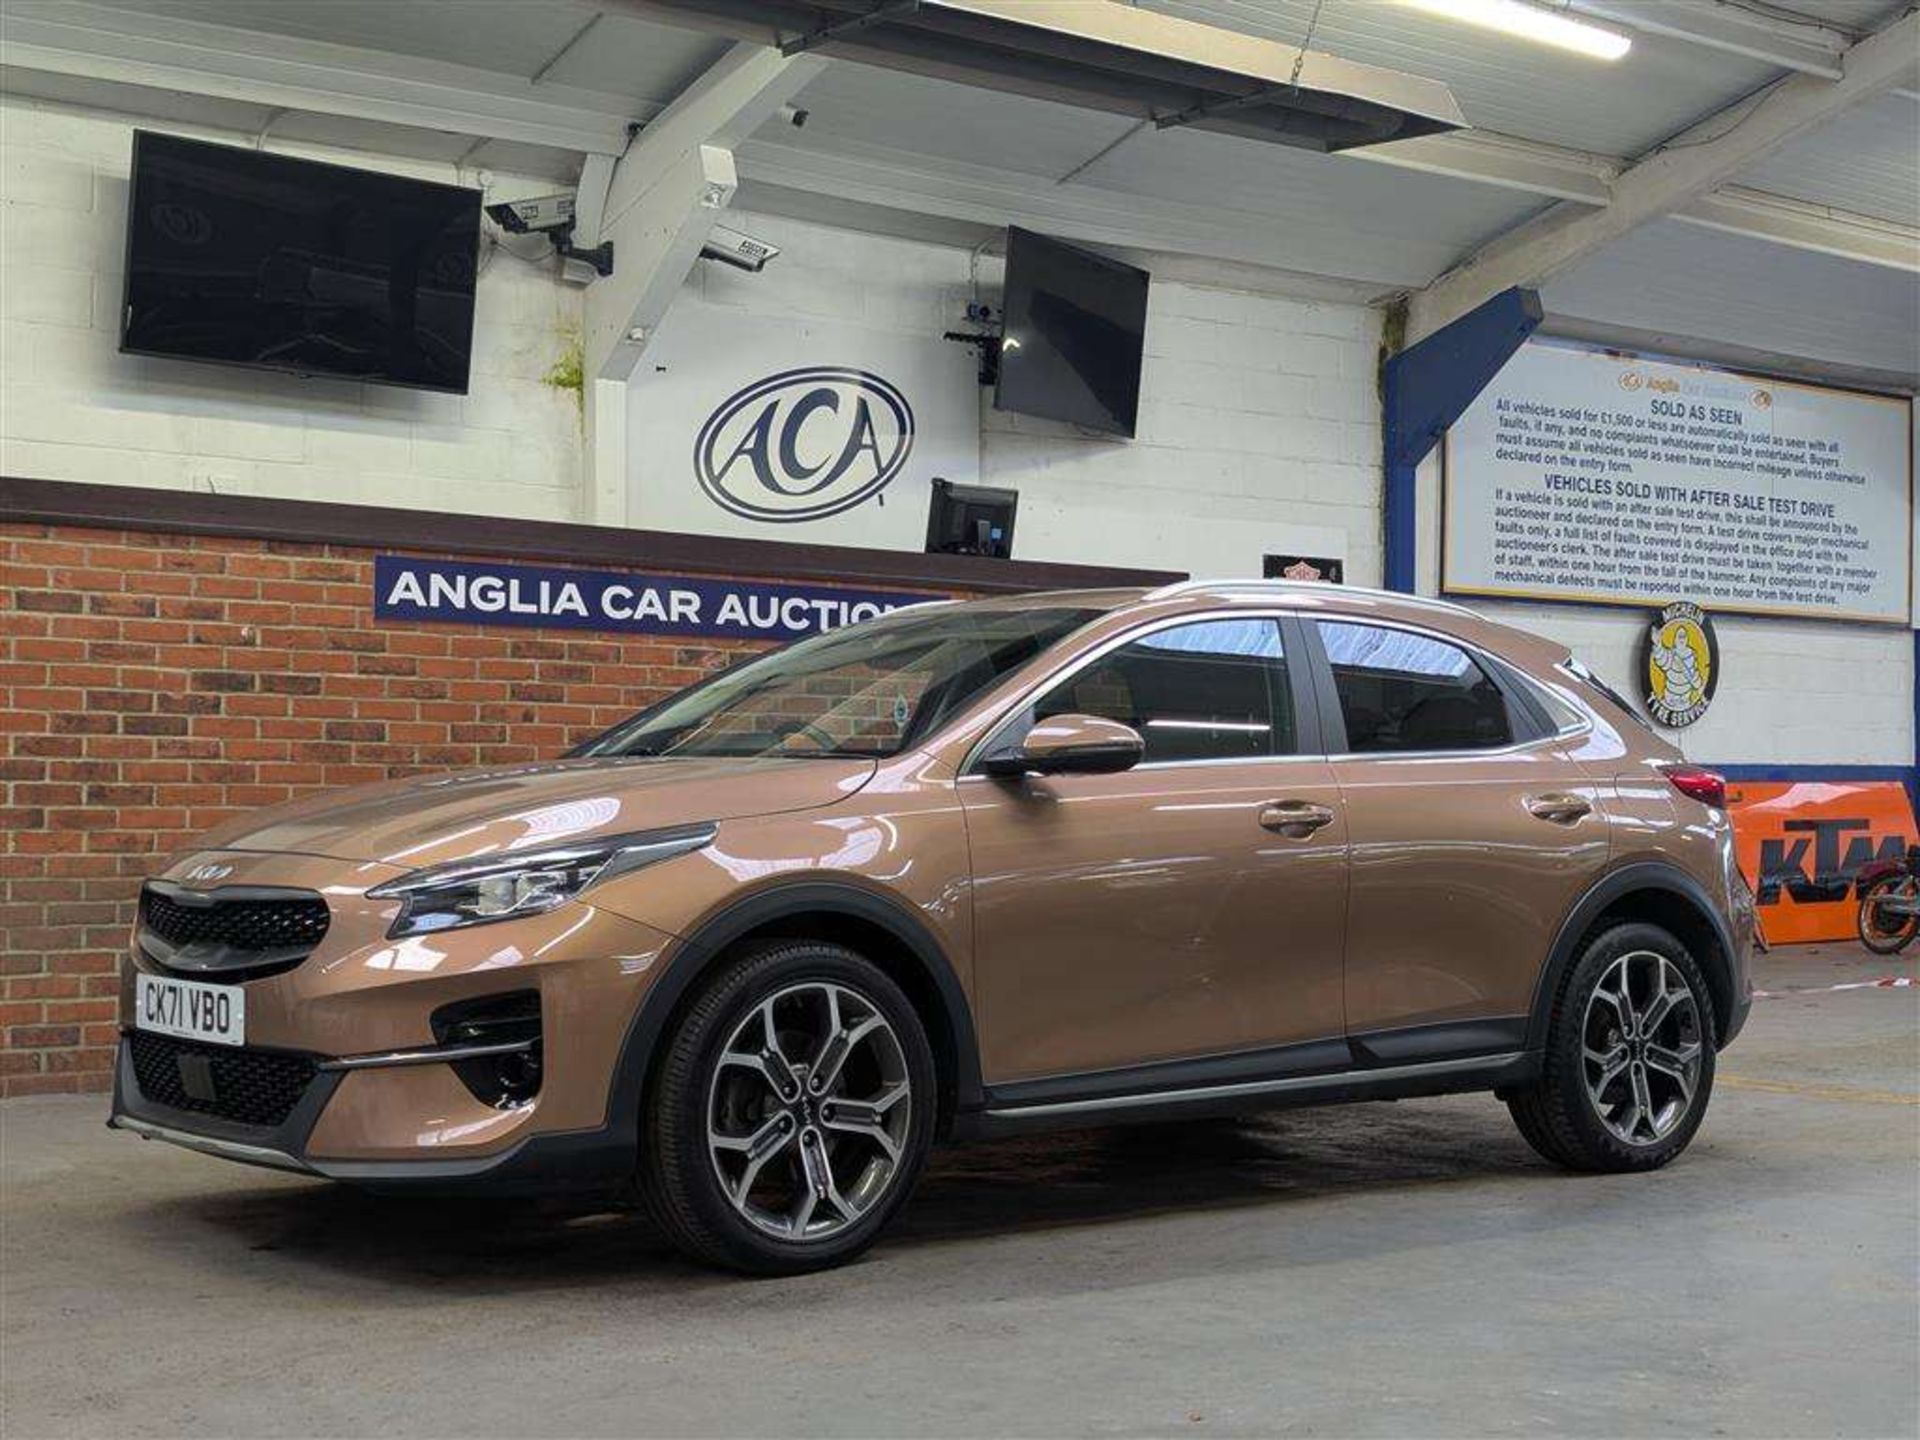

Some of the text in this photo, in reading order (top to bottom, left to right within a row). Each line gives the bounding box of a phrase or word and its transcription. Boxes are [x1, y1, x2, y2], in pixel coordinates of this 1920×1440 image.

[1496, 400, 1509, 412] All
[1512, 403, 1555, 417] vehicles
[1560, 409, 1580, 420] sold
[1584, 410, 1598, 422] for
[1634, 419, 1644, 428] or
[1648, 418, 1668, 431] less
[1671, 423, 1685, 433] are
[1688, 424, 1748, 443] automatically
[1750, 432, 1770, 443] sold
[1772, 436, 1783, 445] as
[1786, 437, 1806, 448] seen
[1809, 438, 1826, 450] with
[1828, 440, 1838, 452] all
[1651, 400, 1742, 424] SOLD AS SEEN
[716, 388, 883, 495] ACA
[1496, 435, 1865, 484] must assume all vehicles sold as seen have incorrect mileage unless otherwise
[1496, 448, 1541, 463] declared
[1544, 455, 1558, 464] on
[1560, 454, 1576, 466] the
[1580, 457, 1605, 471] entry
[1534, 420, 1542, 431] if
[1569, 426, 1586, 437] and
[1590, 429, 1602, 438] no
[1604, 431, 1658, 445] complaints
[1660, 436, 1715, 452] whatsoever
[1718, 442, 1738, 455] shall
[1741, 444, 1752, 456] be
[1809, 452, 1838, 467] Buyers
[1496, 488, 1502, 500] If
[1506, 492, 1511, 501] a
[1514, 492, 1550, 504] vehicle
[1554, 494, 1564, 506] is
[1567, 497, 1588, 508] sold
[1592, 499, 1612, 510] with
[1616, 503, 1628, 512] an
[1630, 502, 1651, 514] after
[1654, 505, 1673, 516] sale
[1676, 506, 1694, 519] test
[1725, 511, 1742, 523] this
[1746, 514, 1766, 526] shall
[1769, 515, 1780, 527] be
[1783, 519, 1830, 532] announced
[1832, 521, 1842, 535] by
[1844, 523, 1858, 534] the
[1544, 475, 1834, 517] VEHICLES SOLD WITH AFTER SALE TEST DRIVE
[1495, 507, 1550, 521] auctioneer
[1554, 512, 1572, 523] and
[1575, 512, 1618, 527] declared
[1622, 519, 1634, 528] on
[1636, 518, 1651, 530] the
[1654, 520, 1678, 534] entry
[1708, 524, 1714, 535] A
[1717, 525, 1734, 537] test
[1737, 527, 1760, 539] drive
[1762, 531, 1792, 542] covers
[1795, 534, 1819, 546] major
[1821, 536, 1869, 549] mechanical
[1496, 521, 1524, 534] faults
[1554, 529, 1560, 537] a
[1564, 527, 1580, 539] full
[1583, 529, 1598, 540] list
[1601, 531, 1612, 542] of
[1614, 531, 1641, 544] faults
[1644, 536, 1680, 547] covered
[1684, 537, 1692, 548] is
[1695, 538, 1740, 554] displayed
[1742, 542, 1750, 553] in
[1753, 543, 1766, 554] the
[1770, 544, 1794, 557] office
[1796, 547, 1812, 558] and
[1816, 548, 1832, 560] with
[1835, 549, 1848, 561] the
[1494, 554, 1506, 565] of
[1538, 557, 1569, 569] within
[1572, 561, 1590, 571] one
[1593, 560, 1616, 573] hour
[1619, 562, 1642, 574] from
[1644, 564, 1659, 576] the
[1662, 565, 1676, 577] fall
[1678, 567, 1688, 578] of
[1691, 567, 1705, 579] the
[1750, 572, 1766, 586] Any
[1769, 575, 1816, 588] complaints
[1819, 577, 1828, 588] of
[1830, 580, 1844, 592] any
[1847, 581, 1870, 593] major
[1593, 545, 1610, 556] The
[1614, 547, 1636, 559] after
[1639, 549, 1658, 560] sale
[1660, 550, 1678, 562] test
[1682, 551, 1705, 564] drive
[1708, 555, 1730, 566] must
[1733, 555, 1744, 567] be
[1777, 559, 1813, 573] together
[1816, 562, 1834, 574] with
[1836, 566, 1841, 574] a
[1844, 565, 1877, 577] member
[387, 571, 897, 632] ANGLIA CAR AUCTIO
[1494, 570, 1554, 584] mechanical
[1556, 573, 1594, 586] defects
[1598, 577, 1622, 588] must
[1624, 578, 1637, 589] be
[1640, 581, 1680, 593] reported
[1684, 582, 1712, 595] within
[1714, 587, 1730, 596] one
[1732, 585, 1754, 598] hour
[1756, 587, 1778, 599] from
[1780, 589, 1794, 600] the
[1796, 590, 1813, 602] test
[1663, 603, 1703, 624] MICHELIN
[1670, 700, 1711, 726] SERVICE
[146, 982, 230, 1034] CK71 VBO
